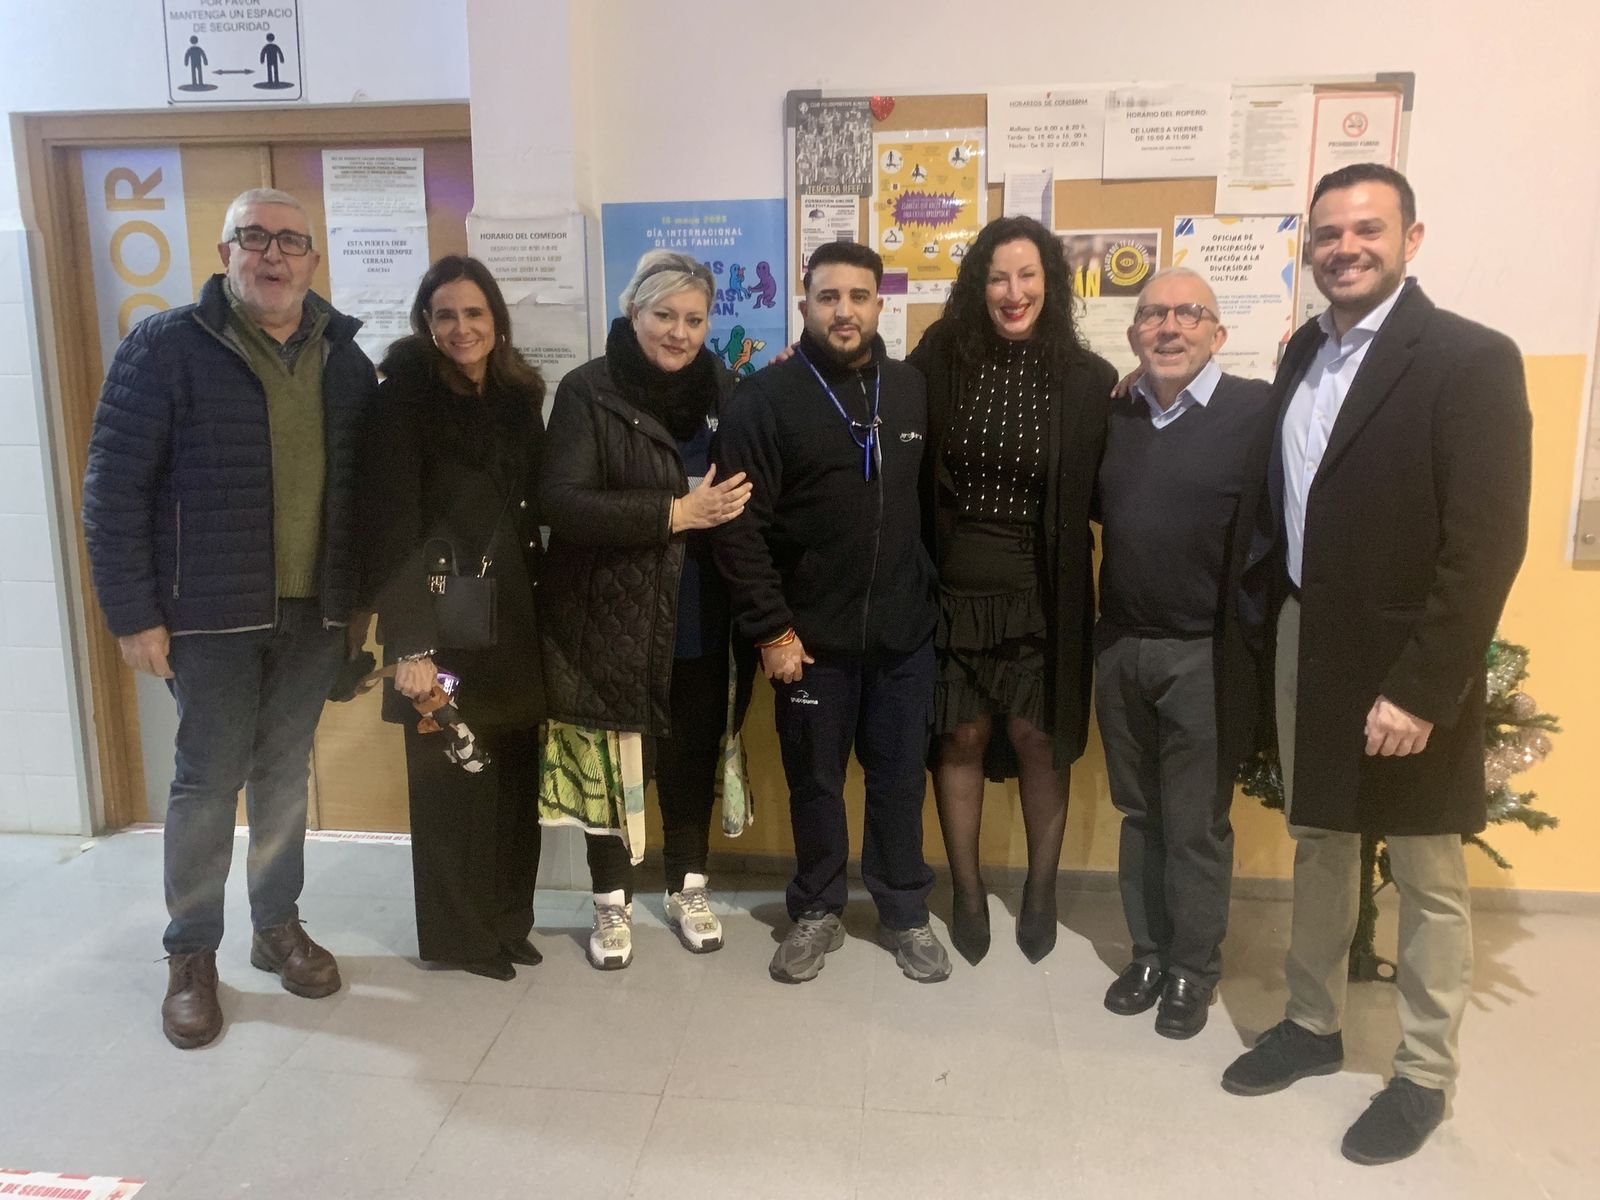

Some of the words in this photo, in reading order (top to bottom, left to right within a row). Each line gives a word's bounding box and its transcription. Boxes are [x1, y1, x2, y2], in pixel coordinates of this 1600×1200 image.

[170, 10, 226, 20] MANTENGA
[229, 10, 244, 19] UN
[247, 8, 293, 18] ESPACIO
[193, 23, 207, 33] DE
[210, 21, 270, 32] SEGURIDAD
[1126, 111, 1159, 119] HORARIO
[1173, 125, 1204, 133] VIERNES
[515, 232, 528, 240] DEL
[530, 232, 568, 240] COMEDOR
[646, 227, 663, 238] DÍA
[667, 227, 743, 237] INTERNACIONAL
[655, 239, 665, 247] DE
[670, 239, 687, 247] LAS
[691, 238, 735, 247] FAMILIAS
[1212, 234, 1242, 242] OFICINA
[1200, 243, 1257, 252] PARTICIPACIÓN
[1204, 254, 1241, 262] ATENCIÓN
[1209, 264, 1253, 272] DIVERSIDAD
[1210, 274, 1249, 282] CULTURAL
[695, 922, 715, 931] EXE
[602, 938, 624, 949] EXE
[1, 1183, 18, 1194] DE
[18, 1184, 92, 1200] SEGURIDAD
